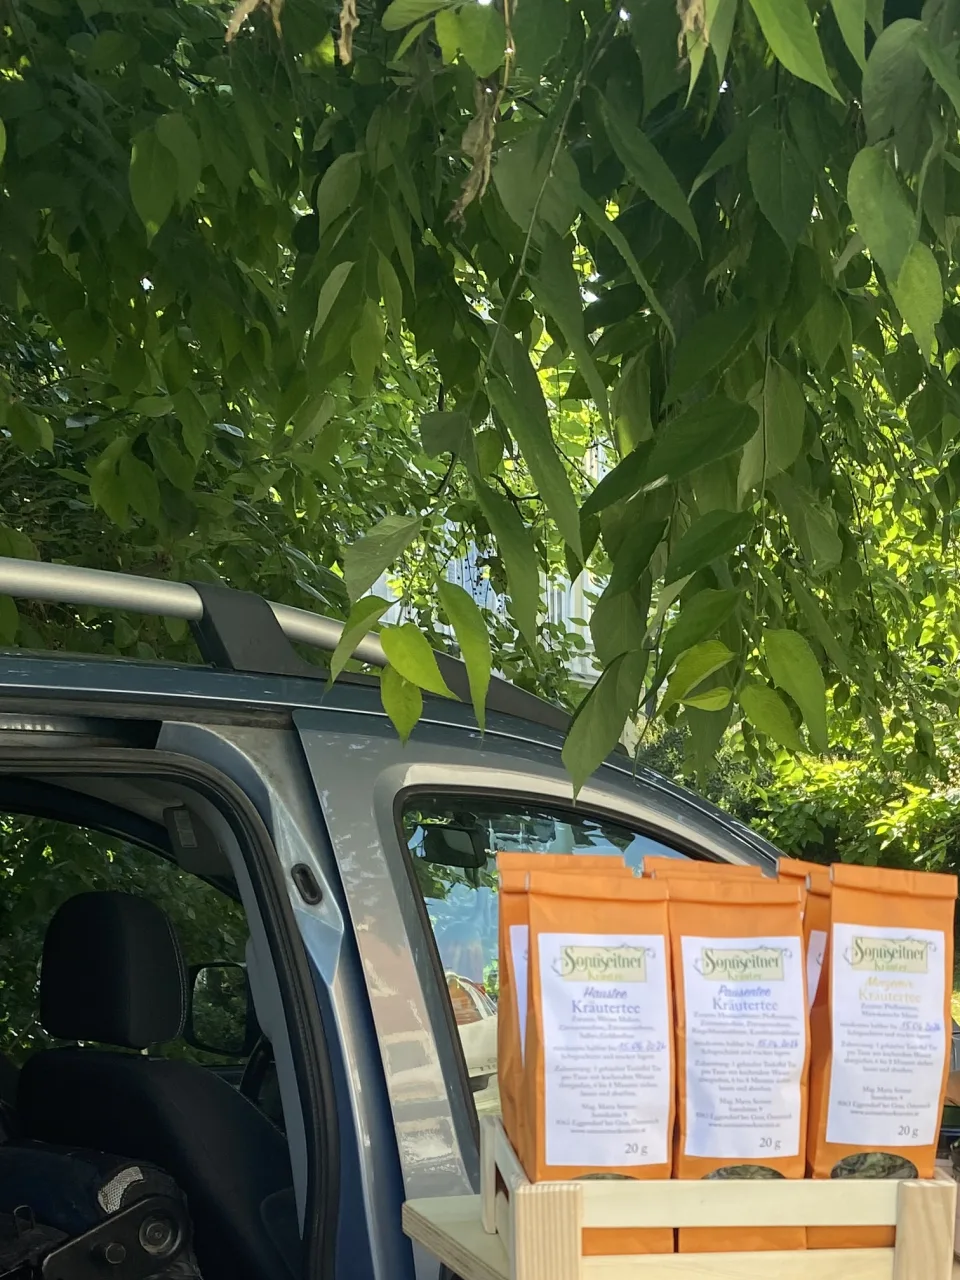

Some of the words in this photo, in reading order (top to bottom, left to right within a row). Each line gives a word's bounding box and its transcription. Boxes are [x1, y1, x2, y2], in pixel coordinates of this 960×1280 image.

[583, 985, 628, 999] Haustee
[718, 984, 771, 998] Pausentee
[858, 987, 922, 1004] Kräutertee
[571, 999, 641, 1014] Kräutertee
[712, 996, 779, 1012] Kräutertee
[898, 1125, 911, 1136] 20
[911, 1128, 919, 1139] g
[624, 1142, 639, 1155] 20
[640, 1144, 648, 1156] g
[759, 1137, 773, 1148] 20
[774, 1138, 781, 1150] g
